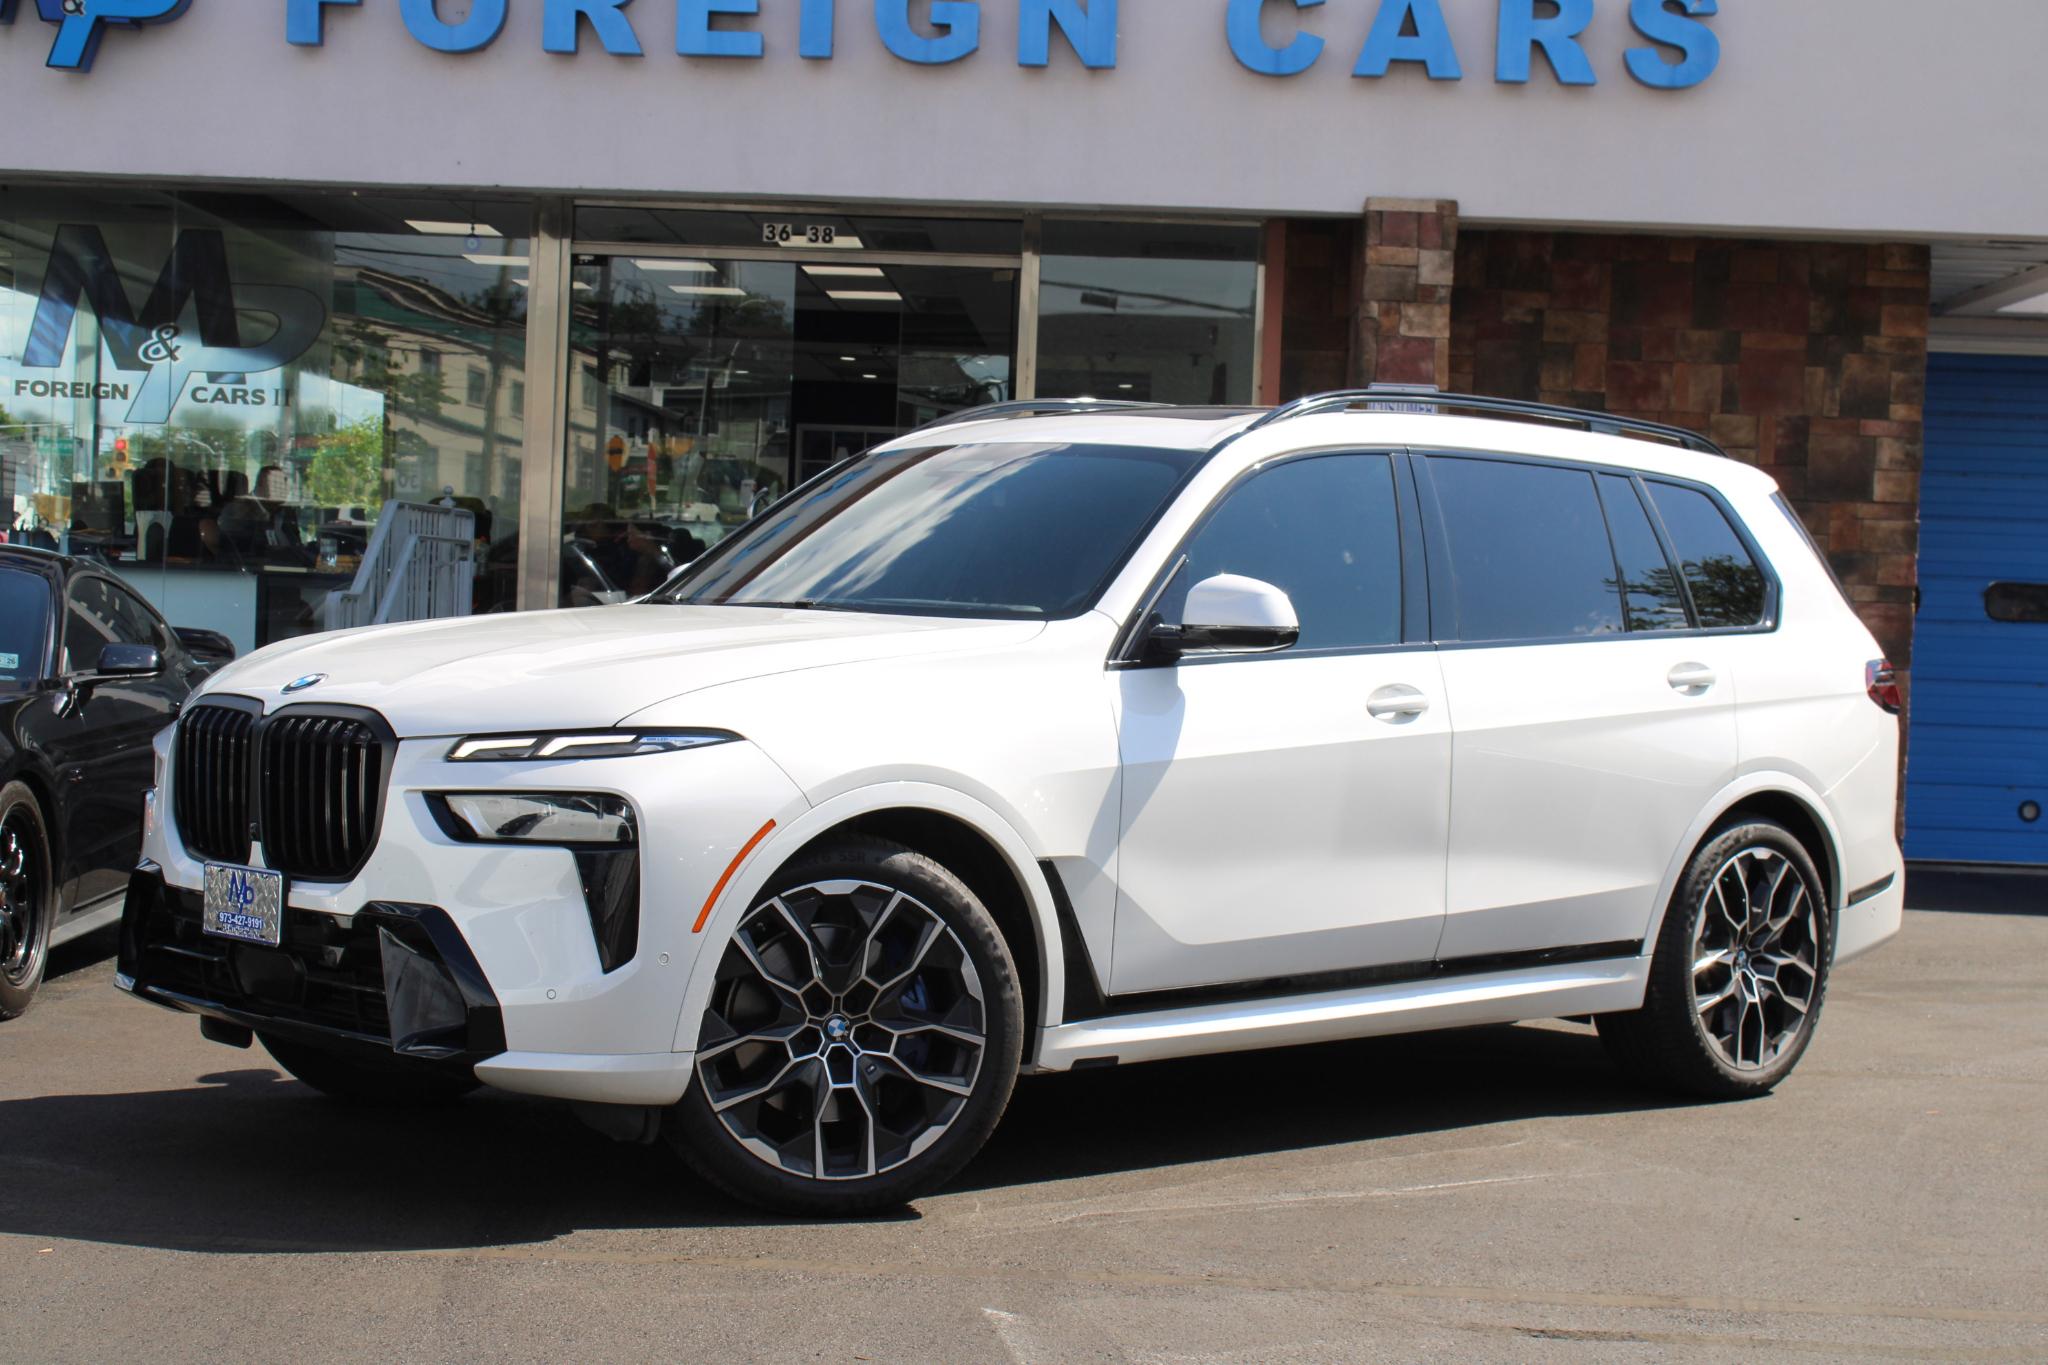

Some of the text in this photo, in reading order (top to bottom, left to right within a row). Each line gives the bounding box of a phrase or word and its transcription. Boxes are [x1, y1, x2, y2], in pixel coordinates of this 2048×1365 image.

[1225, 0, 1721, 90] CARS
[764, 223, 833, 244] 36 38
[14, 379, 129, 400] FOREIGN
[190, 386, 266, 406] CARS
[219, 911, 263, 930] 973-427-9191
